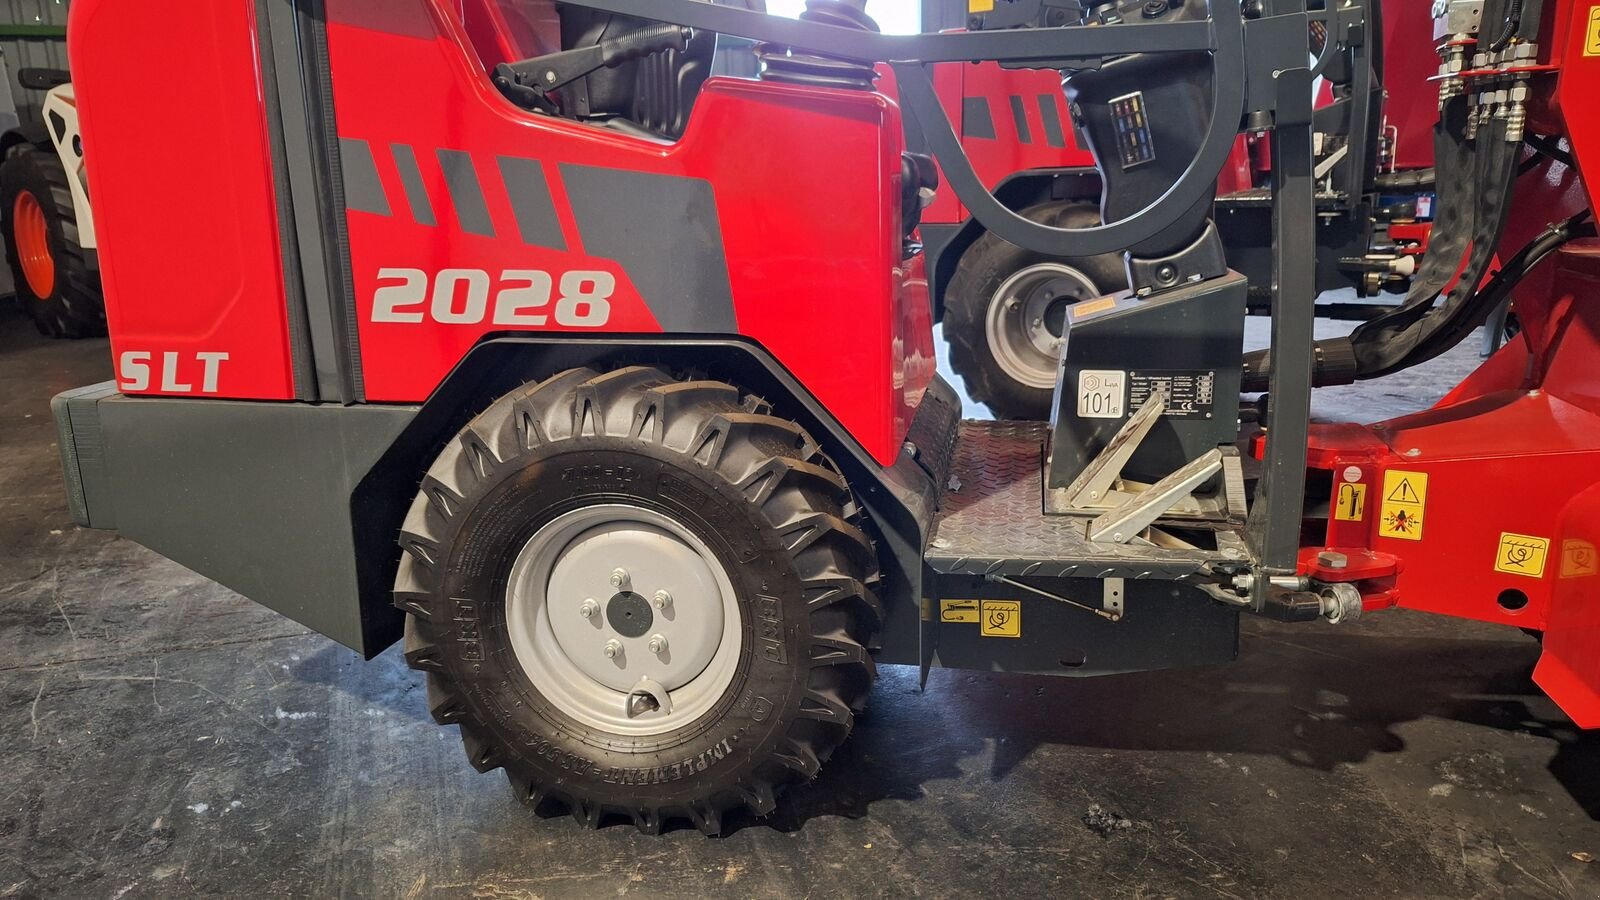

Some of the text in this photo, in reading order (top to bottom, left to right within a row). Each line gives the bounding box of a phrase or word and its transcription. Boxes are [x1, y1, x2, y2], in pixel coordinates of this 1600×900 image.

[371, 267, 616, 327] 2028
[119, 350, 230, 393] SLT
[1083, 392, 1111, 414] 101
